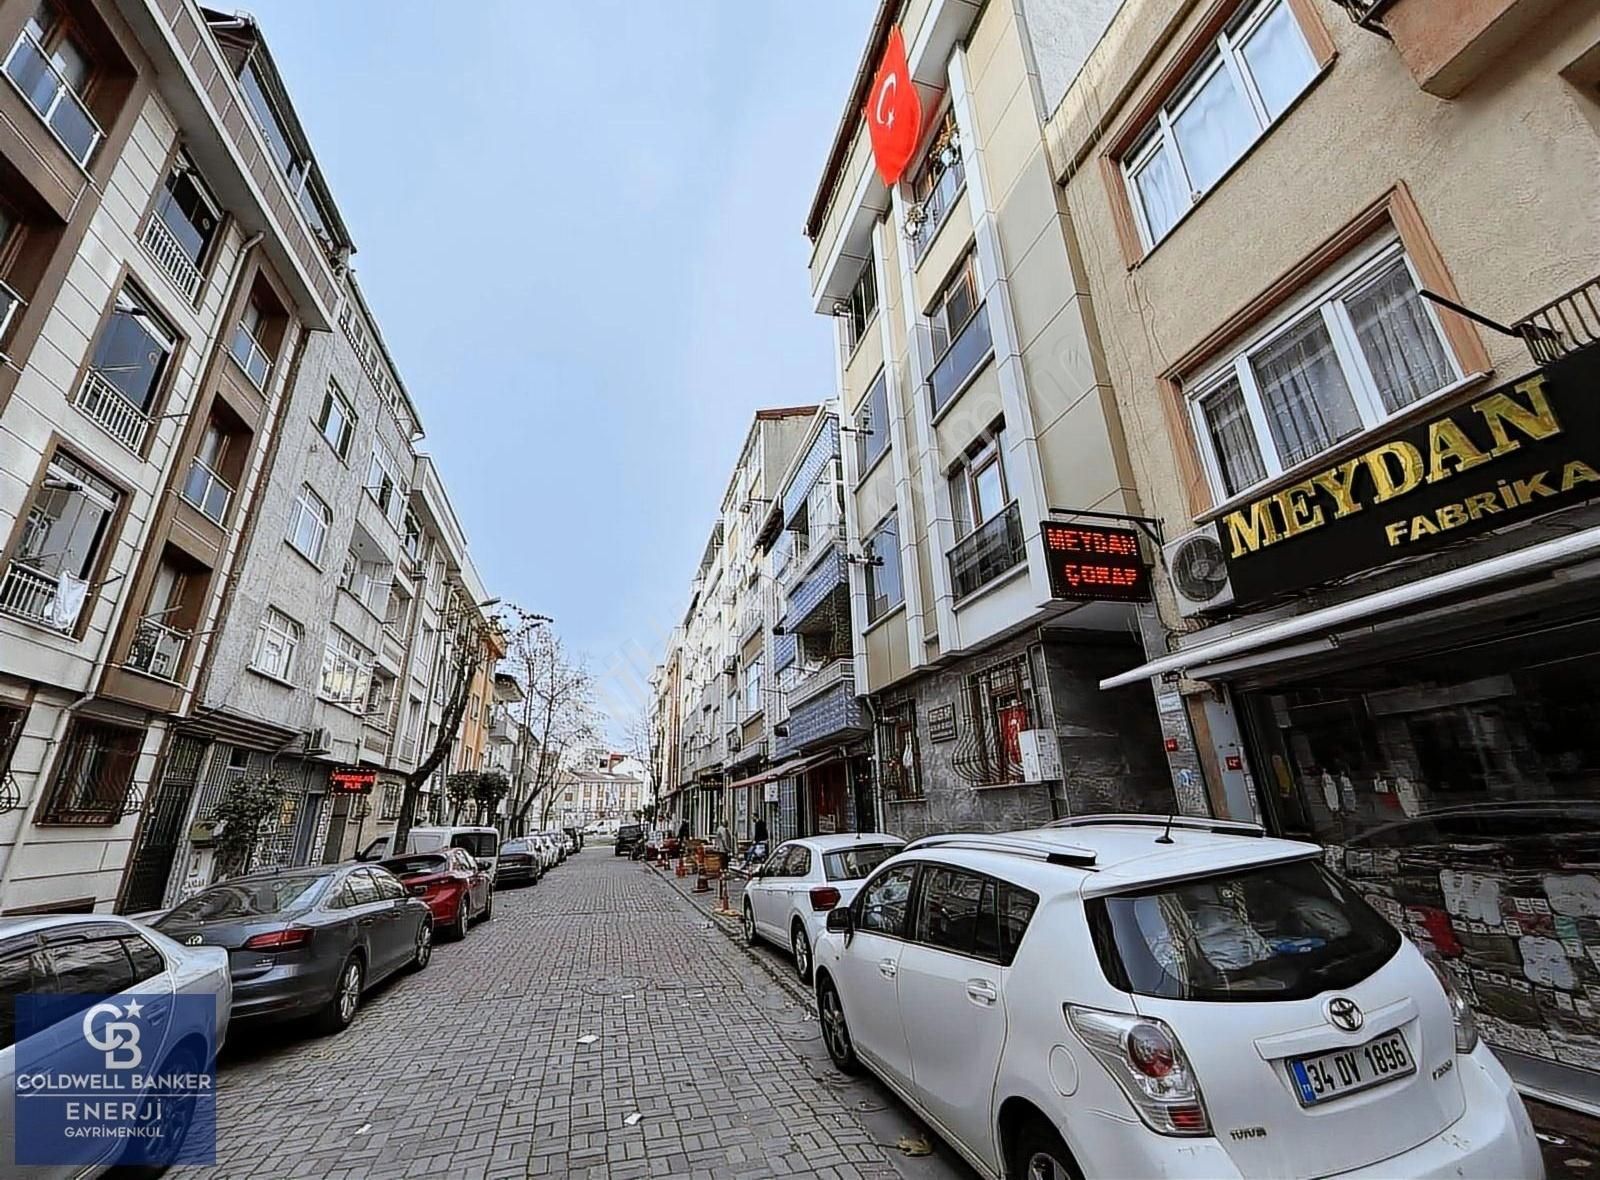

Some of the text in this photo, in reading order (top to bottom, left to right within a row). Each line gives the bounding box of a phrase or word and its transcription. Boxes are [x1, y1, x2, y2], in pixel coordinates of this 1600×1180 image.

[1222, 374, 1562, 559] MEYDAN
[1385, 460, 1600, 546] FABRİKA
[1048, 528, 1138, 556] MEYDAN
[1307, 1063, 1336, 1094] 34
[1334, 1052, 1362, 1086] DV
[1364, 1039, 1407, 1076] 1896
